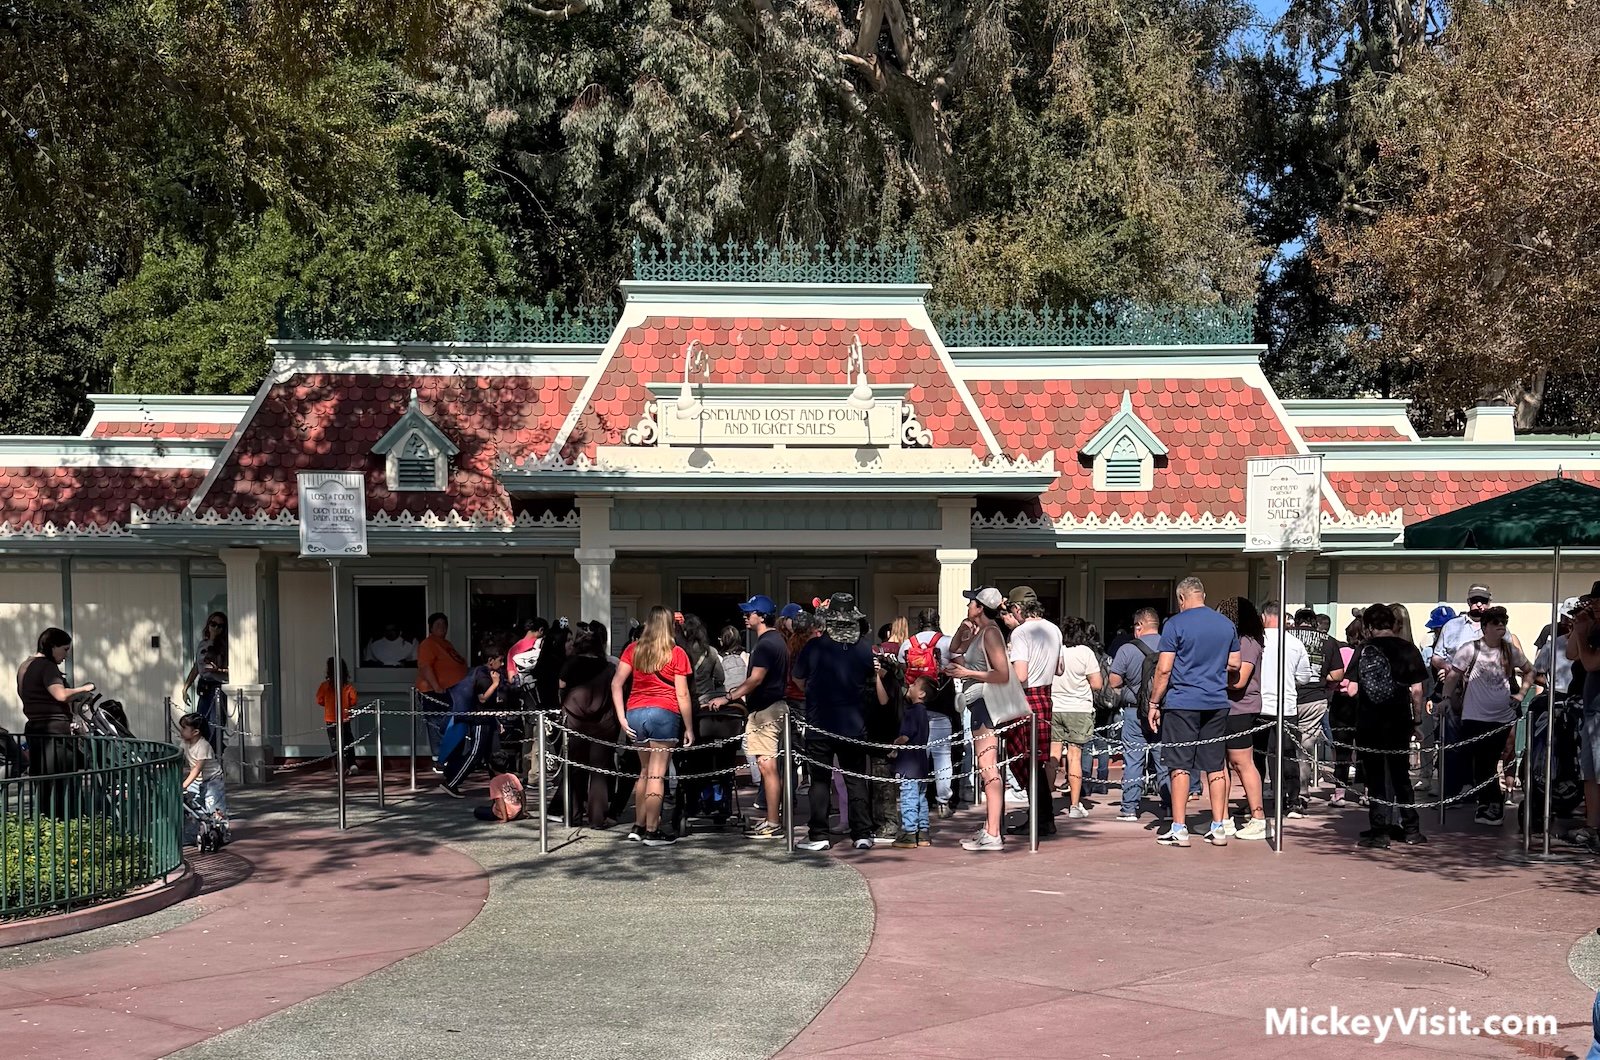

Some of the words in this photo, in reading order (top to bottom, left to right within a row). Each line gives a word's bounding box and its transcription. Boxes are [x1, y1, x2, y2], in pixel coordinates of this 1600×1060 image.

[690, 408, 761, 421] ISNEYLAND
[765, 408, 795, 421] LOST
[800, 408, 824, 421] AND
[828, 408, 869, 421] FOUND
[724, 422, 749, 435] AND
[752, 422, 795, 435] TICKET
[796, 422, 836, 436] SALES
[1267, 496, 1301, 508] TICKET
[1267, 508, 1300, 519] SALES
